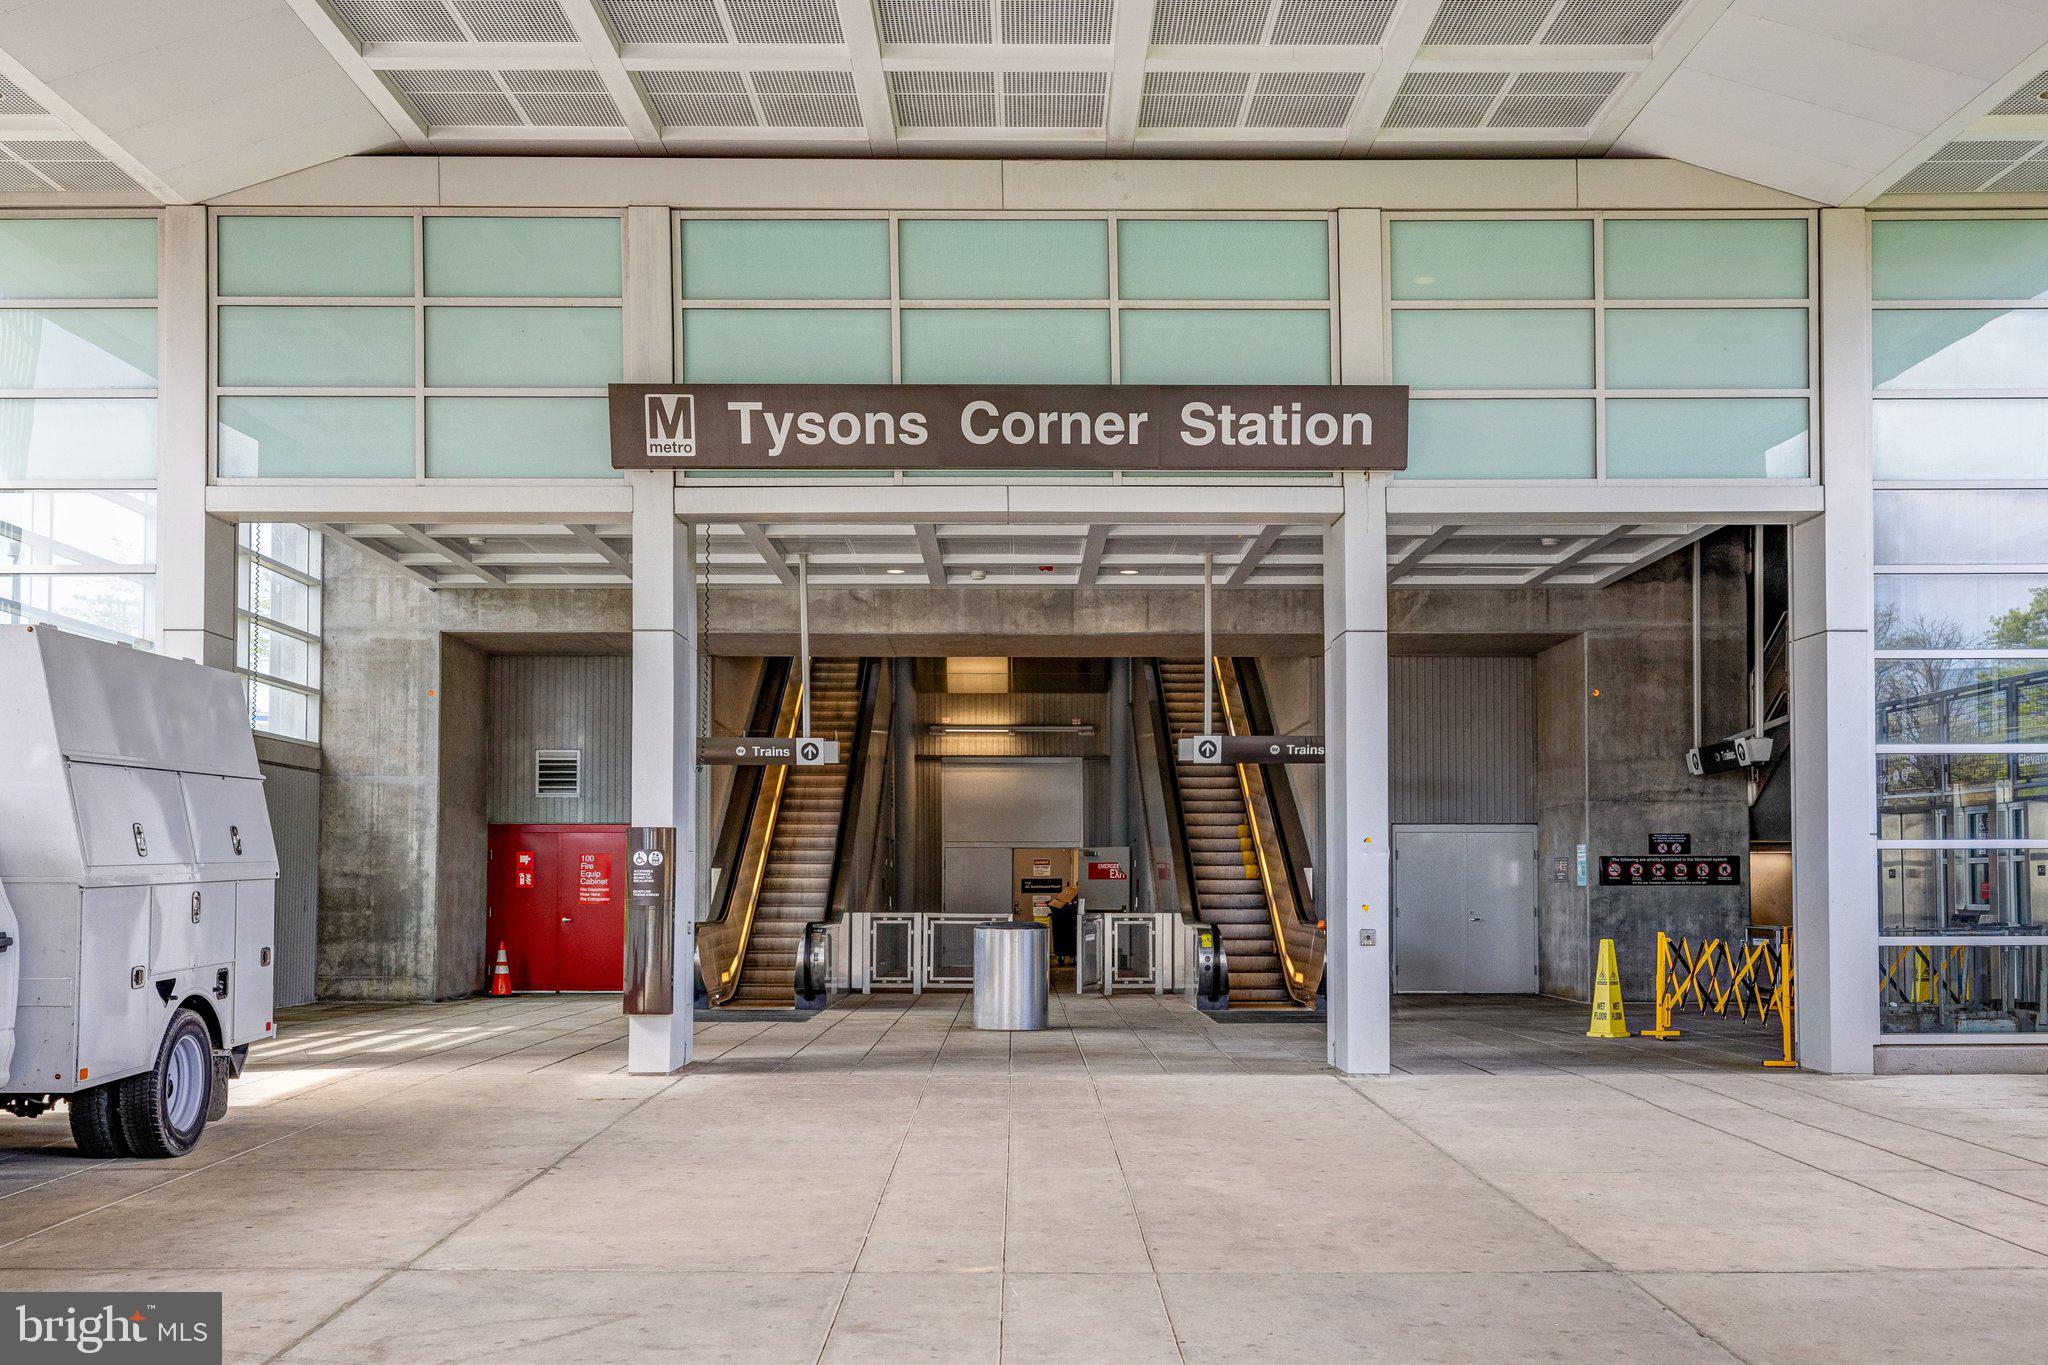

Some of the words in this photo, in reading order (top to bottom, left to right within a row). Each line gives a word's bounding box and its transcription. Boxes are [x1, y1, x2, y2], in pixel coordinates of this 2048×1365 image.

[649, 397, 691, 439] M
[727, 401, 929, 457] Tysons
[960, 400, 1149, 446] Corner
[1180, 401, 1373, 446] Station
[649, 441, 692, 454] metro
[752, 746, 790, 757] Trains
[1287, 744, 1325, 755] Trains
[2018, 754, 2048, 767] Elevato
[580, 870, 601, 878] Equip
[580, 877, 608, 885] Cabinet
[1597, 1002, 1606, 1011] WET
[1612, 1002, 1620, 1011] WET
[1594, 1011, 1607, 1021] FLOOR
[1611, 1011, 1622, 1021] FLOOR
